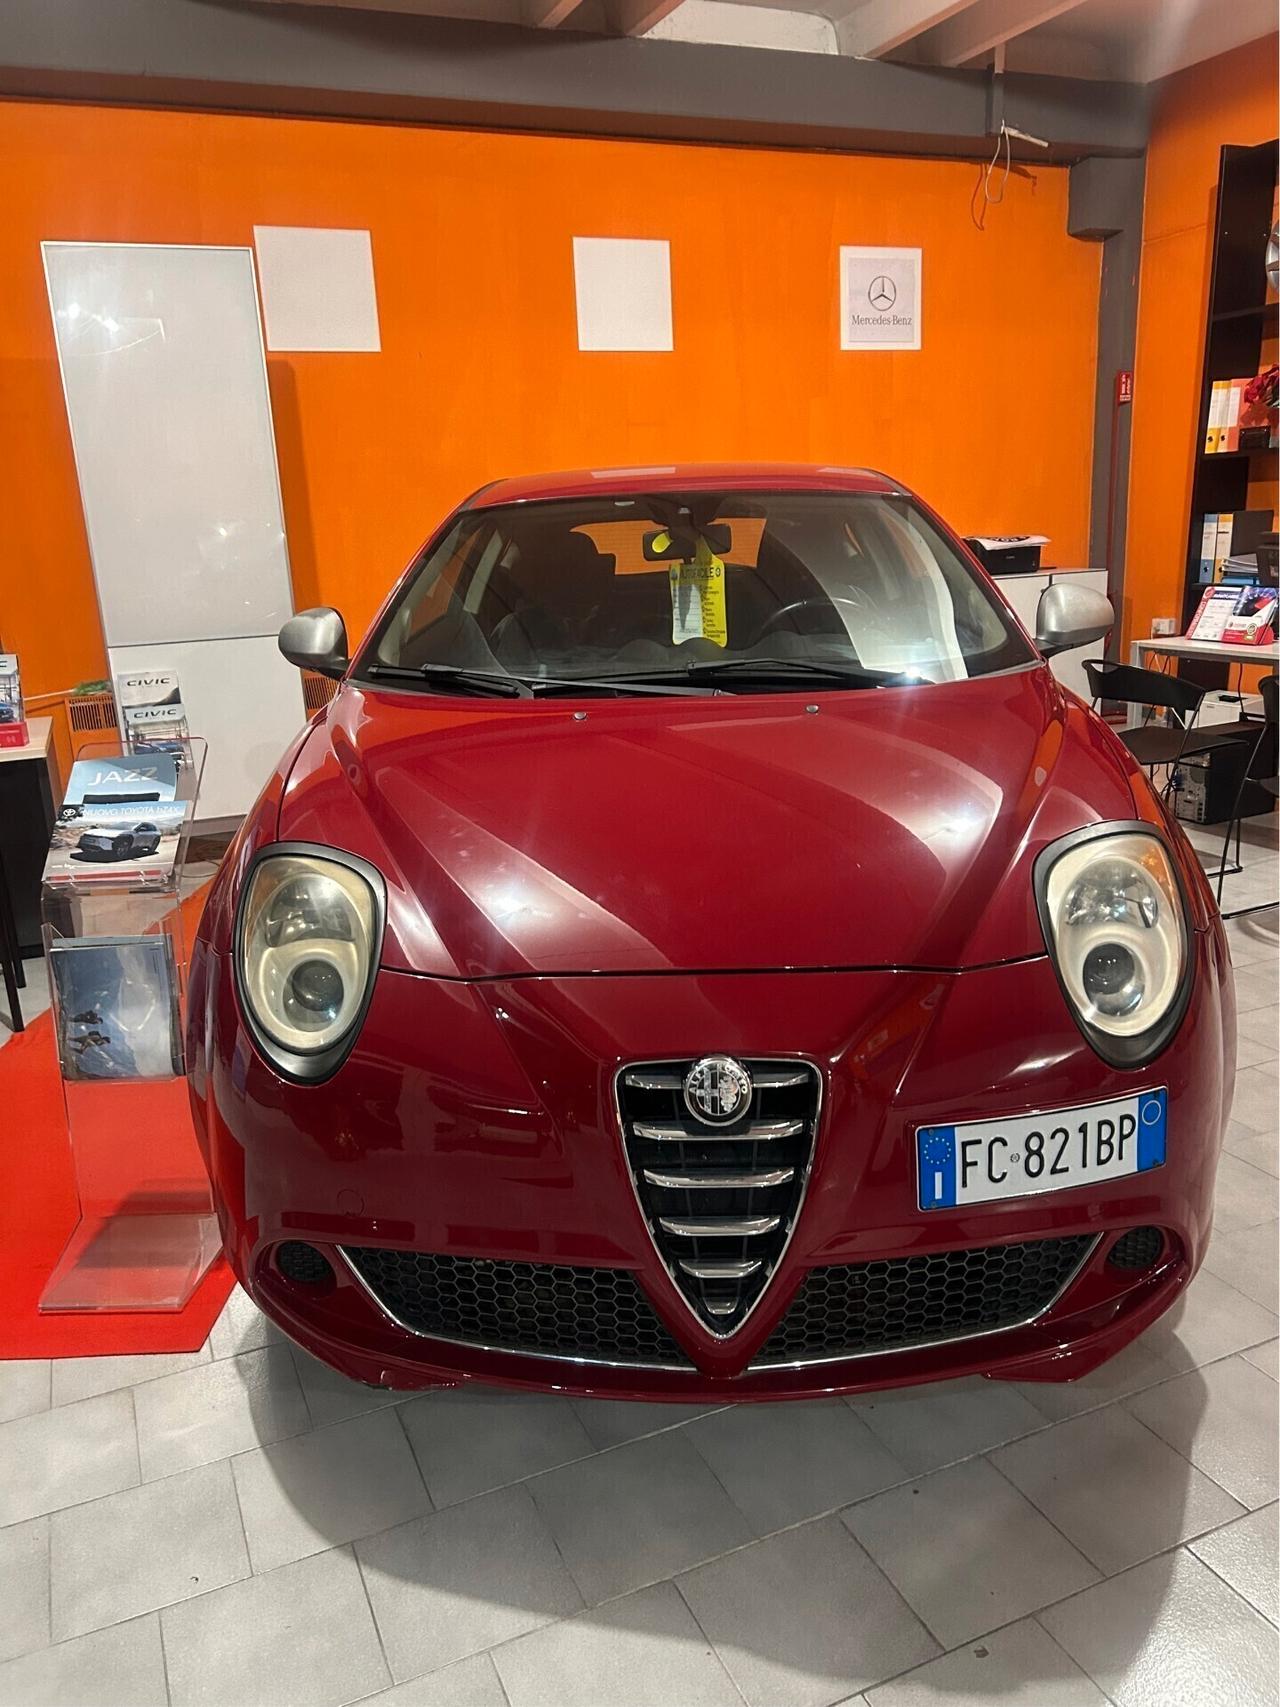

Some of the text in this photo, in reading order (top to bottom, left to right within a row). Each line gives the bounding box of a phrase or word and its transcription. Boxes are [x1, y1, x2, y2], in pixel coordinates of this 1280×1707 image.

[852, 314, 913, 326] Mercedes-Benz
[127, 677, 171, 687] CIVIC
[133, 708, 177, 719] CIVIC
[88, 766, 159, 786] JAZZ
[83, 807, 118, 817] NUOVO
[120, 806, 154, 815] TOYOTA
